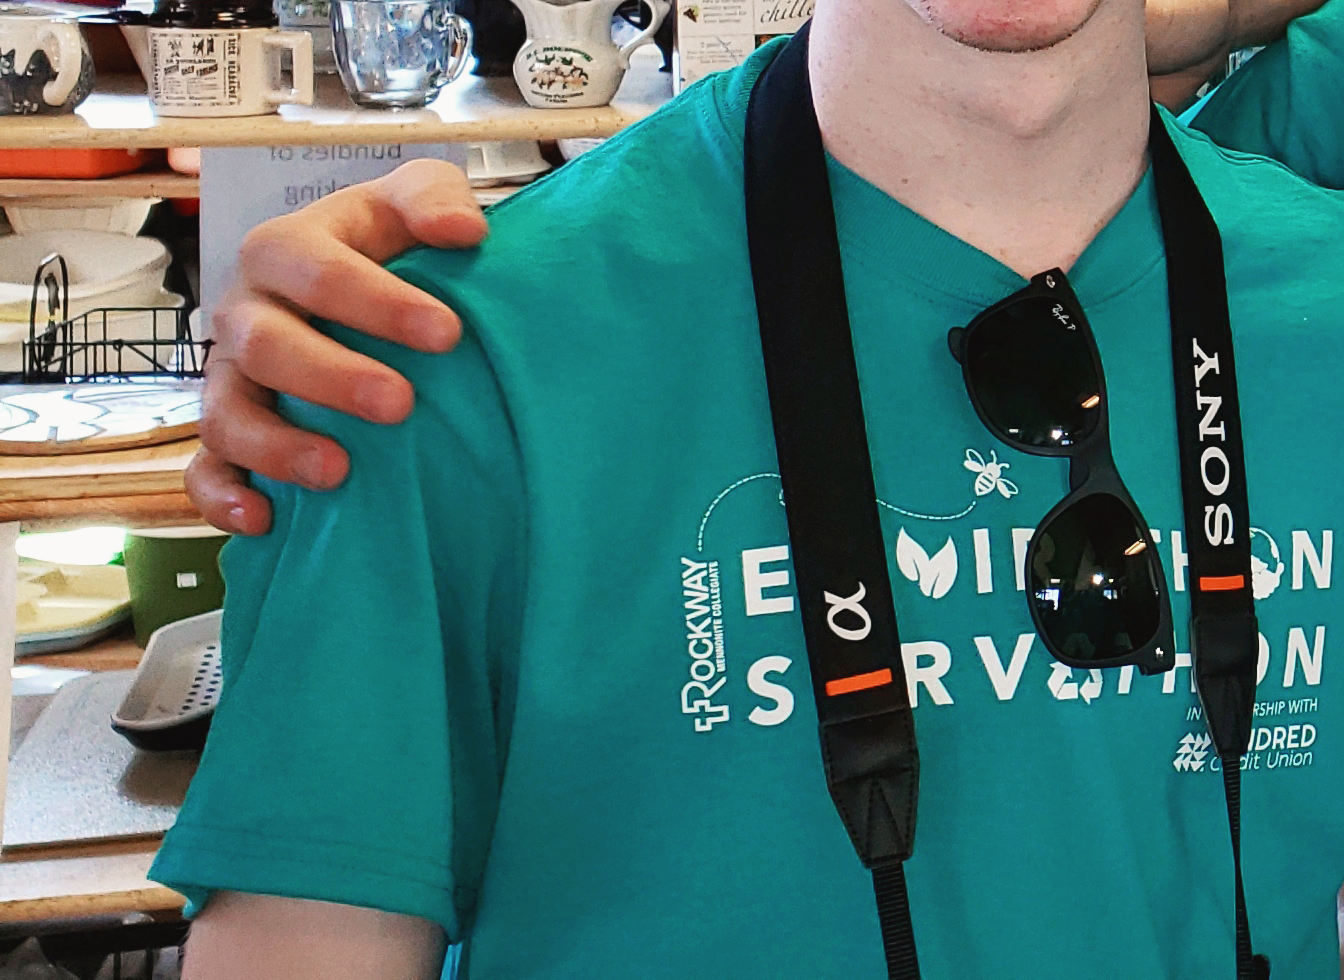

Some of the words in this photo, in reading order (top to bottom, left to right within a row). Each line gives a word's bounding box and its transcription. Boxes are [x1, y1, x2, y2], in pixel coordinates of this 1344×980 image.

[1191, 338, 1235, 547] SONY
[708, 560, 723, 618] COLLEGIATE
[680, 556, 728, 714] ROCKWAY
[713, 618, 727, 673] MENNONITE
[1186, 706, 1202, 721] IN
[1287, 697, 1318, 715] WITH
[1209, 750, 1261, 772] Cdit
[1266, 750, 1314, 769] Union
